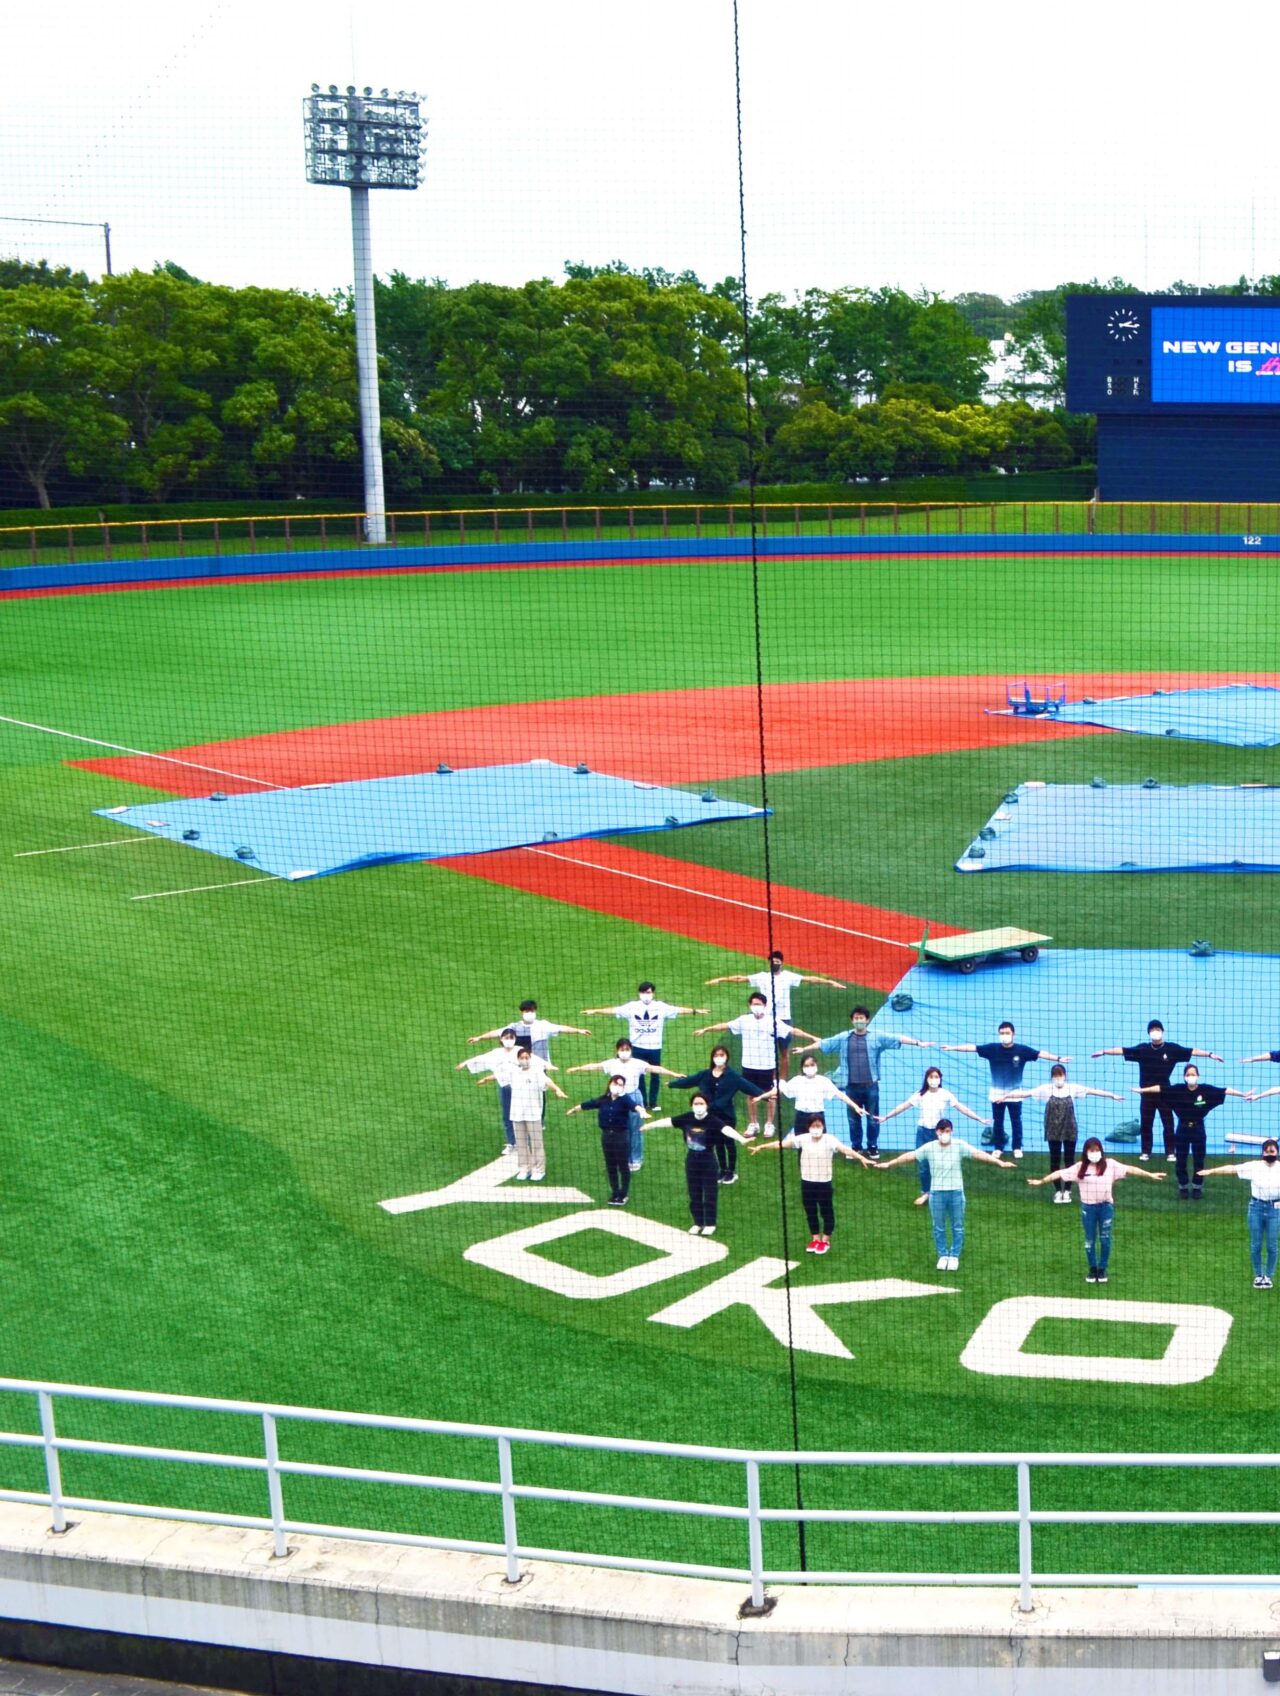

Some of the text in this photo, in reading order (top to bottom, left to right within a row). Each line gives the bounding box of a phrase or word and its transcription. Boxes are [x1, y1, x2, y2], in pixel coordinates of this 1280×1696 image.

[1162, 340, 1221, 354] NEW
[1227, 359, 1253, 373] IS
[1242, 535, 1262, 545] 122
